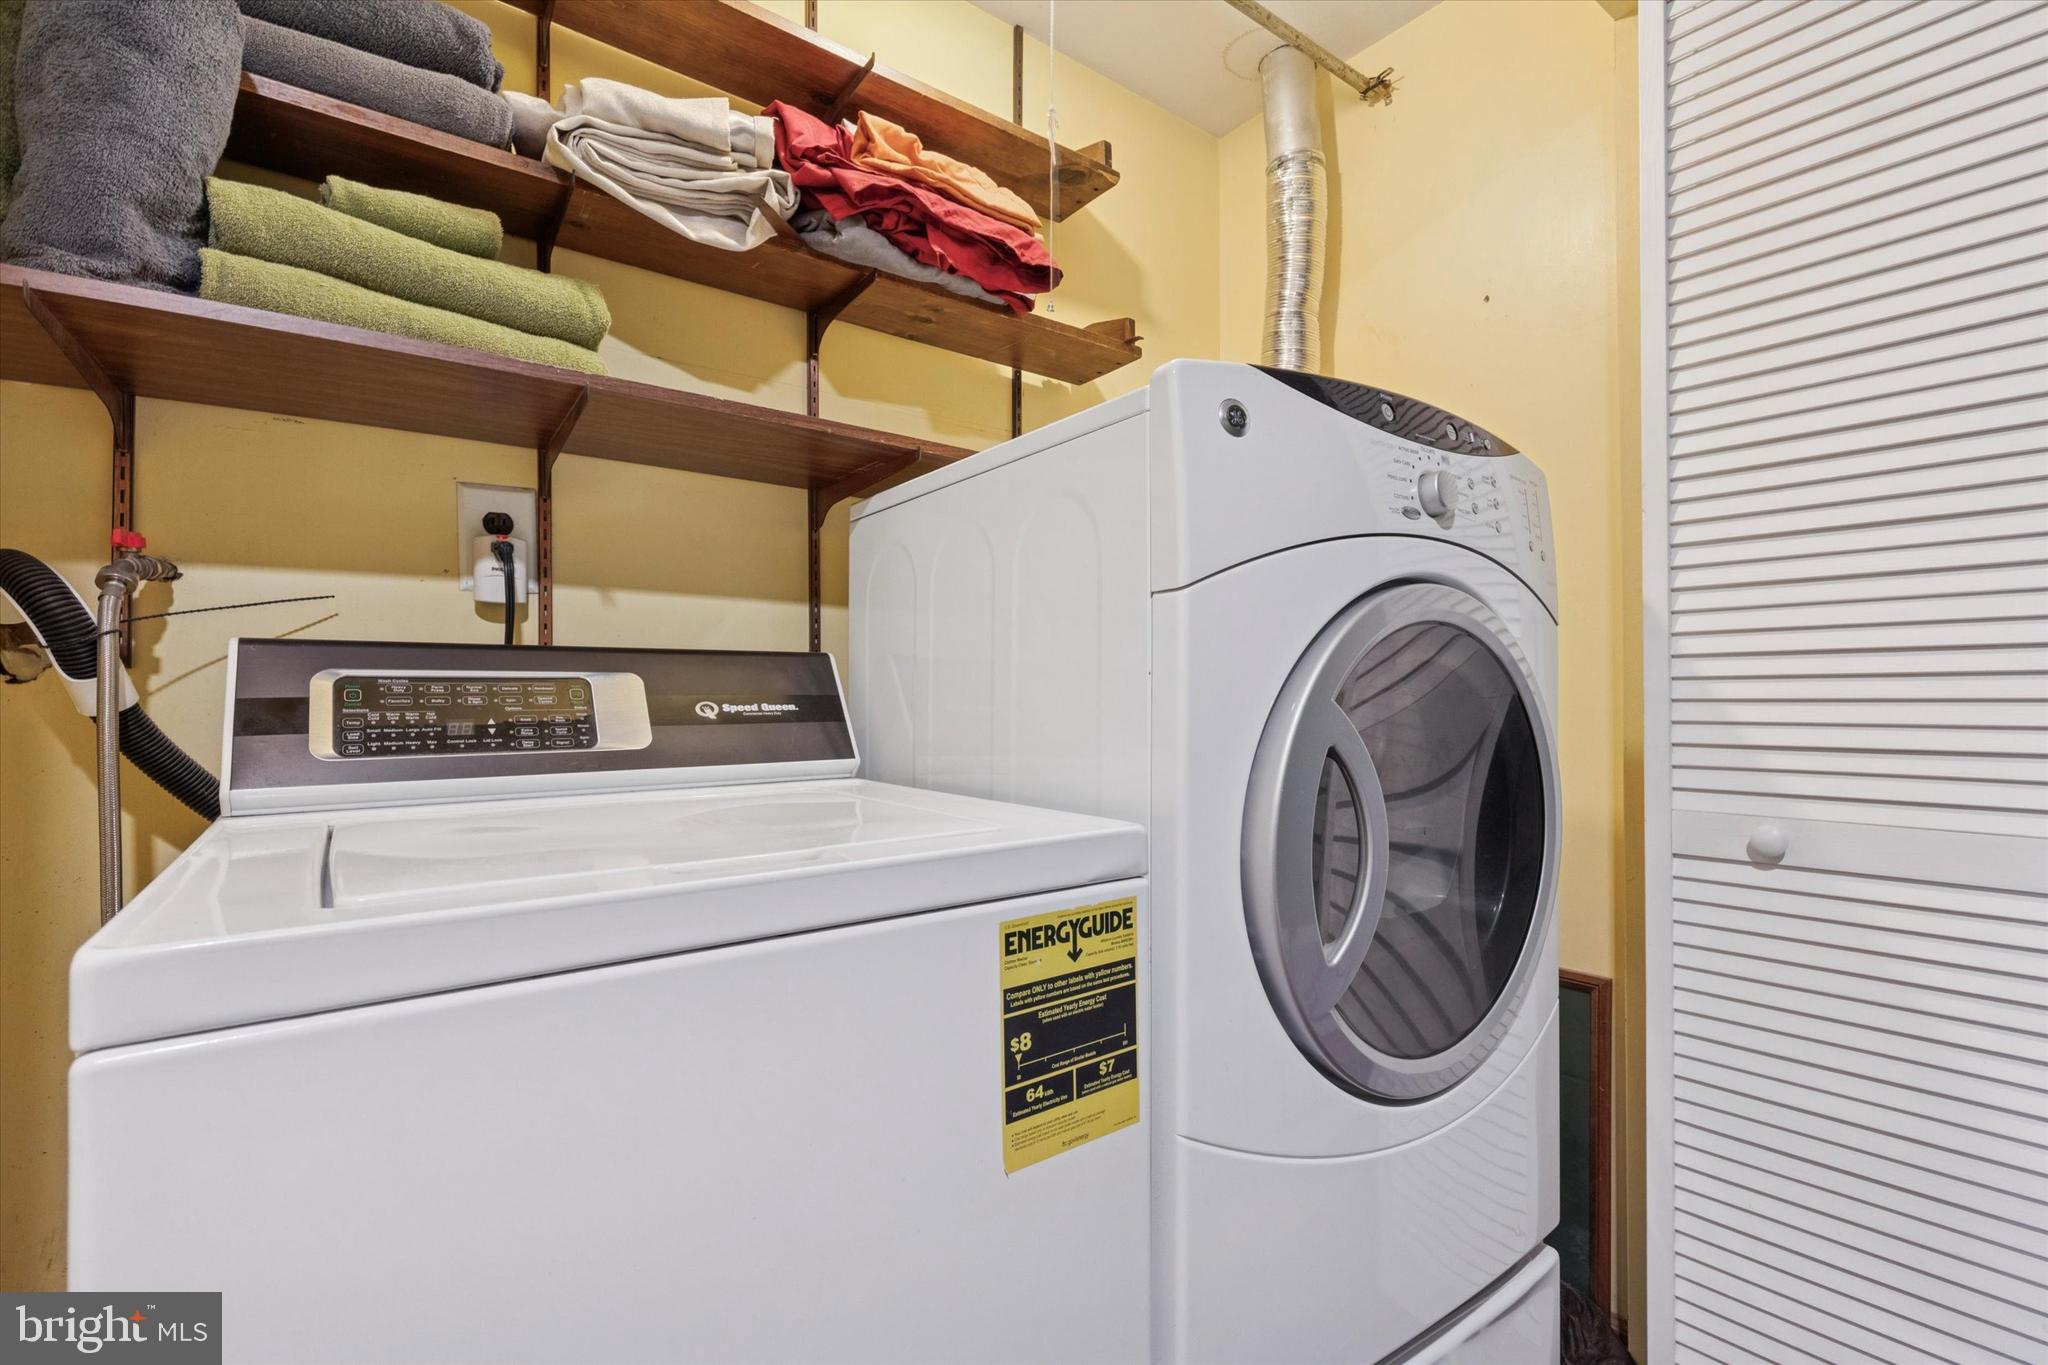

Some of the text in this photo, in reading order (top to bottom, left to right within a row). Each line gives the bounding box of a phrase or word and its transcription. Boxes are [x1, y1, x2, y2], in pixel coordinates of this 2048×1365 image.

[722, 703, 758, 713] Speed
[1004, 906, 1133, 962] ENERGYGUIDE
[1007, 989, 1031, 1001] Compare
[1032, 984, 1047, 994] ONLY
[1054, 980, 1067, 988] other
[1068, 975, 1083, 984] labels
[1095, 969, 1111, 978] yellow
[1112, 963, 1133, 973] numbers.
[1010, 999, 1024, 1007] Labels
[1038, 994, 1107, 1018] Estimated Yearly Energy Cost
[1010, 1032, 1032, 1053] $8
[1099, 1058, 1115, 1076] $7
[1026, 1084, 1044, 1102] 64
[1084, 1079, 1100, 1089] Estimated
[1013, 1107, 1031, 1118] Estimated
[1043, 1098, 1060, 1107] Electricity
